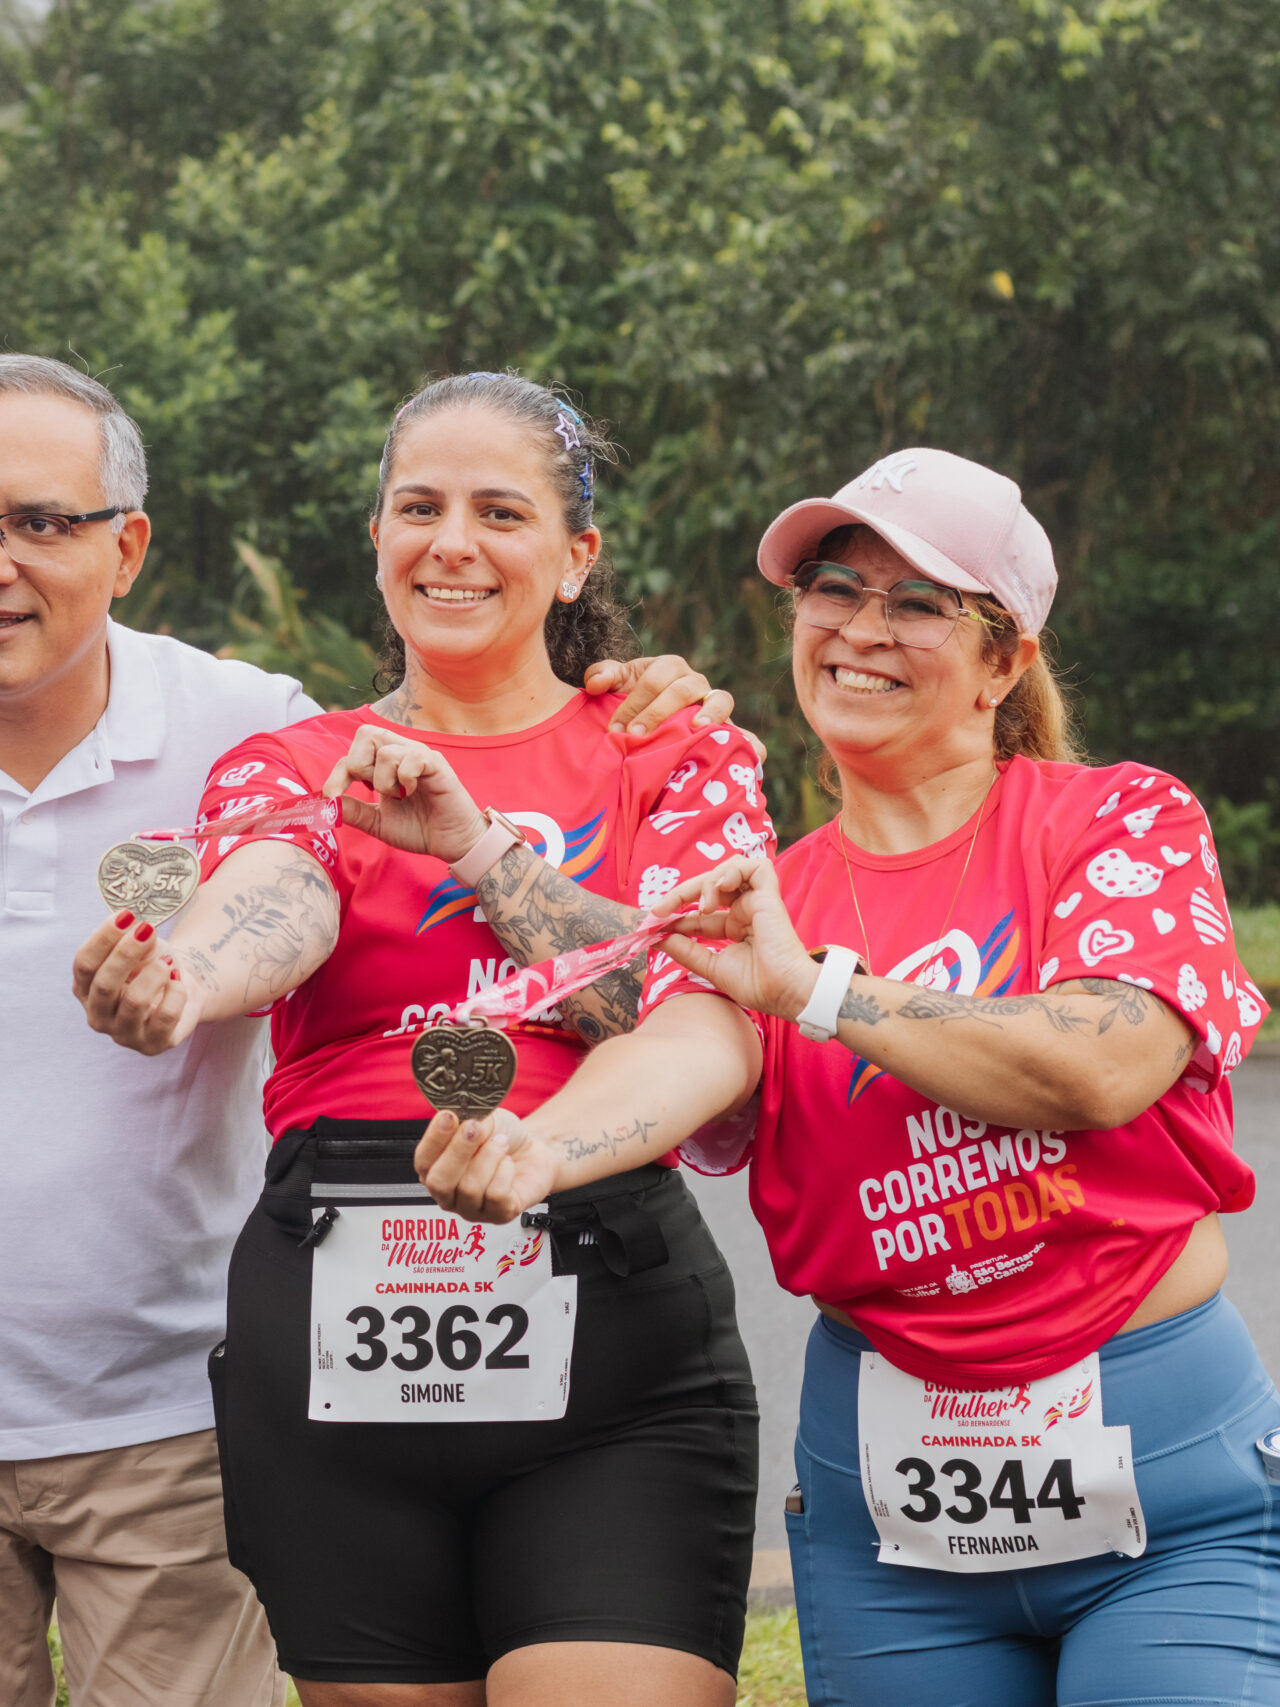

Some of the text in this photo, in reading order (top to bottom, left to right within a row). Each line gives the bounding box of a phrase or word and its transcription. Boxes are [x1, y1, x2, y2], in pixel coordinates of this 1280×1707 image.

[153, 873, 184, 891] 5K
[471, 1062, 502, 1081] 5K
[858, 1128, 1067, 1221] CORREMOS
[382, 1218, 459, 1241] CORRIDA
[871, 1164, 1086, 1271] POR TODAS
[381, 1242, 464, 1267] DA Mulher
[970, 1254, 1008, 1269] PREFEITURA
[973, 1242, 1045, 1278] São Bernardo
[977, 1260, 1033, 1285] do Campo
[375, 1281, 494, 1294] CAMINHADA 5K
[345, 1303, 530, 1372] 3362
[401, 1383, 465, 1403] SIMONE
[931, 1394, 1008, 1420] Mulher
[921, 1435, 1041, 1447] CAMINHADA 5K
[895, 1457, 1086, 1524] 3344
[948, 1535, 1039, 1555] FERNANDA
